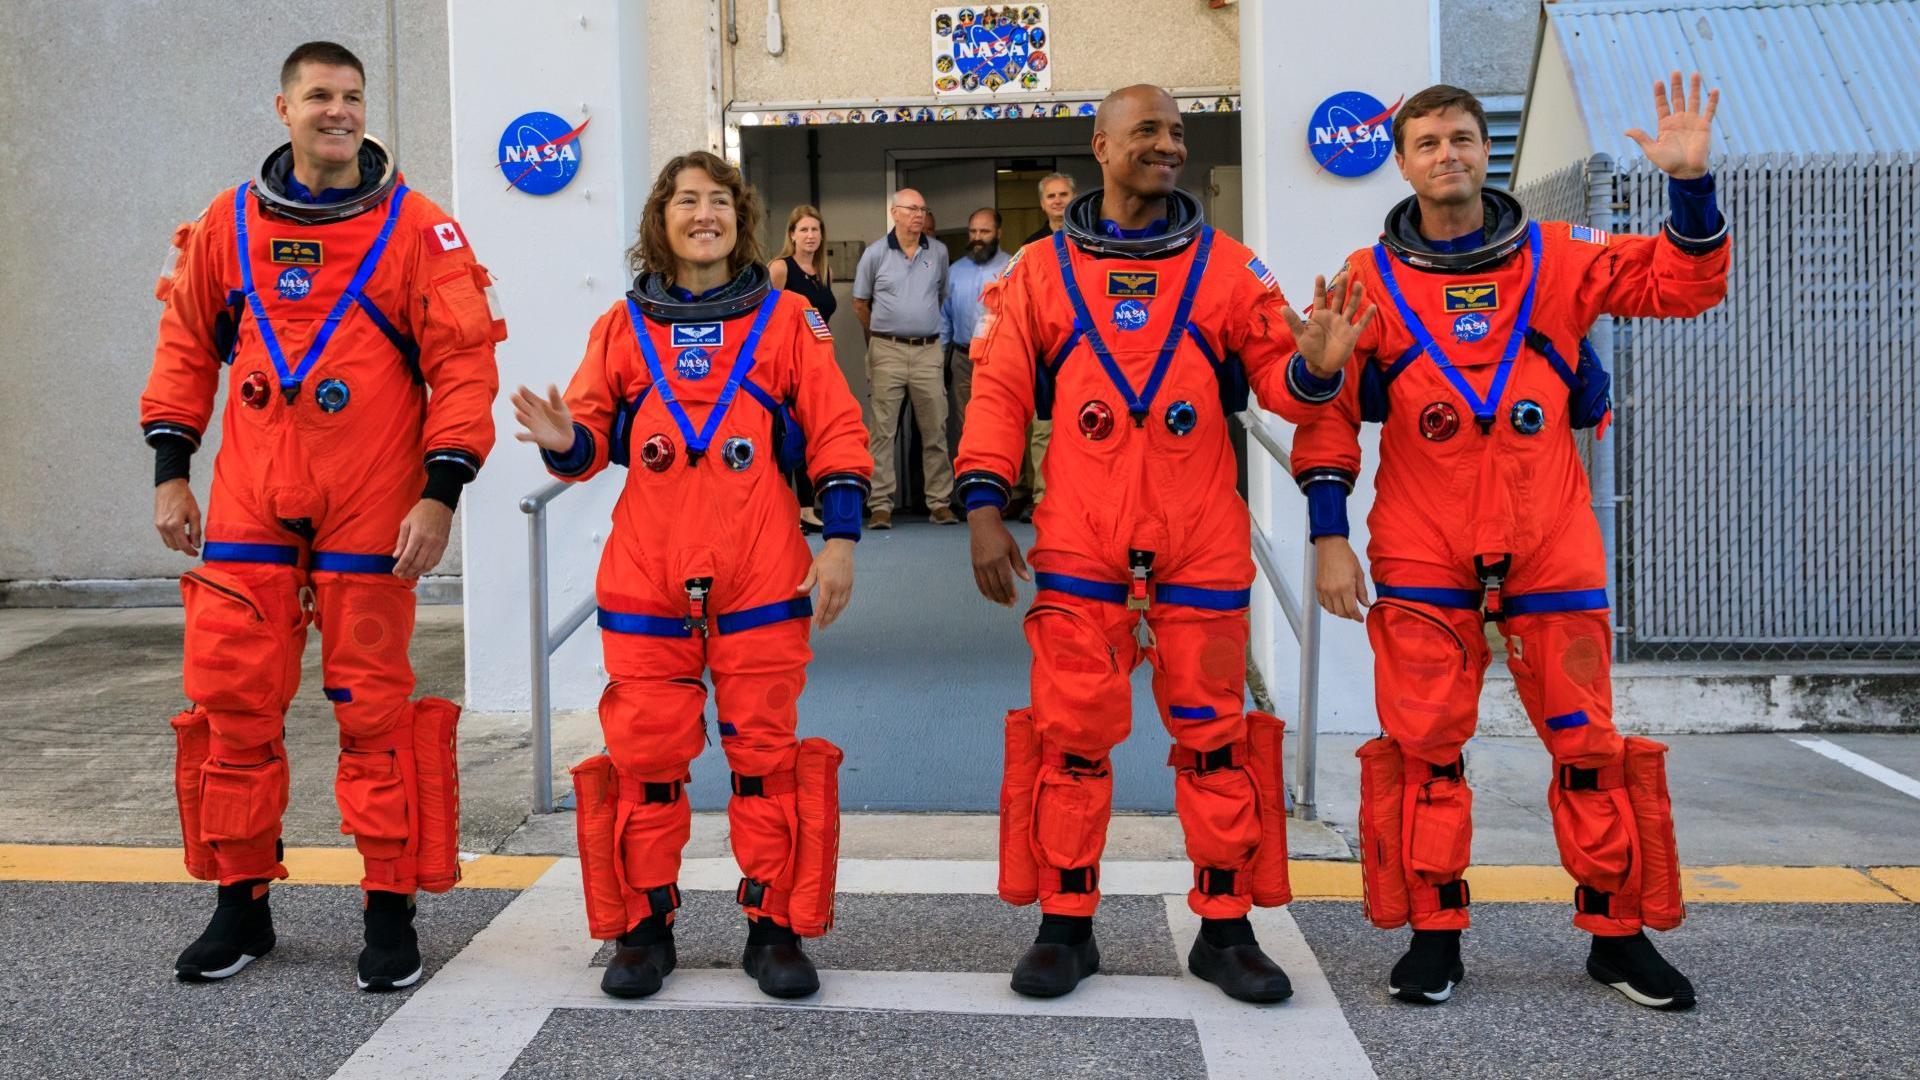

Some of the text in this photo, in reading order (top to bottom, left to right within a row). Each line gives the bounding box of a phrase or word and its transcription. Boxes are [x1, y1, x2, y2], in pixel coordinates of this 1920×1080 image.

[959, 40, 1025, 59] NASA
[1315, 124, 1390, 145] NASA
[505, 144, 577, 163] NASA
[280, 279, 310, 288] NASA
[1115, 310, 1146, 319] NASA
[1456, 321, 1488, 332] NASA
[679, 359, 710, 368] NASA
